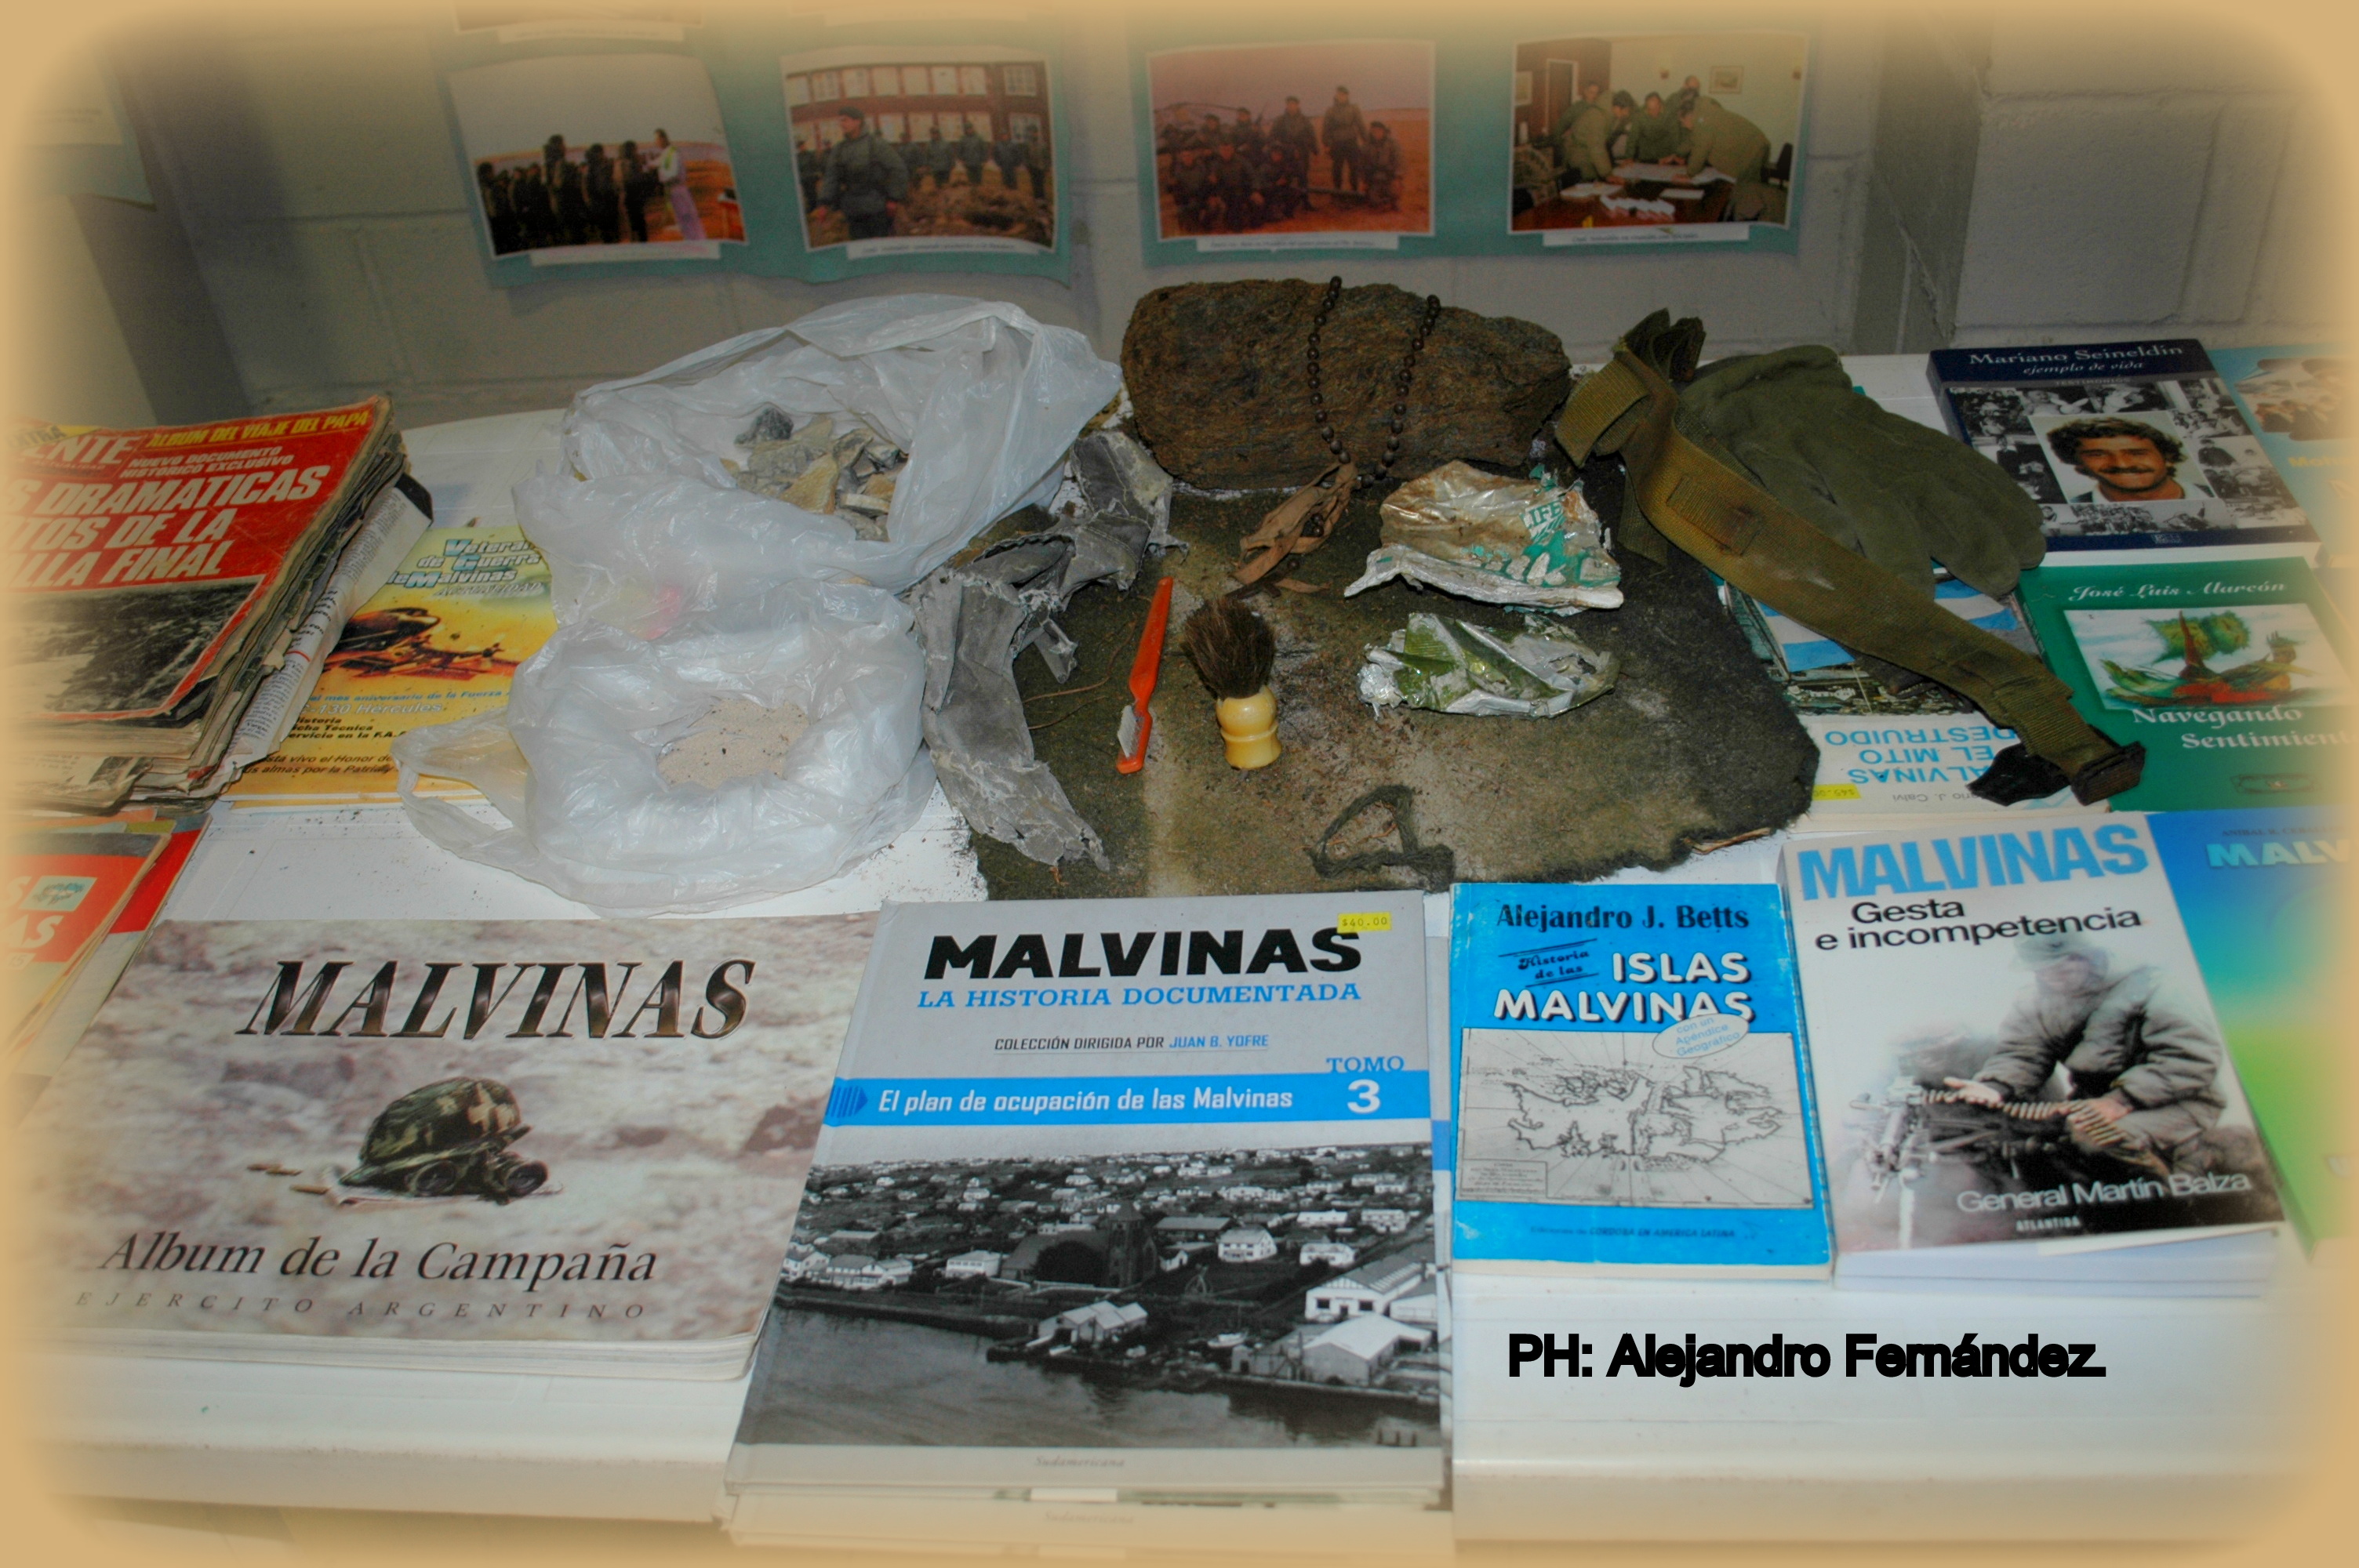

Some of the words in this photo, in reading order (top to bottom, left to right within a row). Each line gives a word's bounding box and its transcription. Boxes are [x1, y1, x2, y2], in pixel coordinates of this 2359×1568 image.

[1969, 353, 2068, 365] Mariano
[2074, 345, 2183, 361] Seineldin
[2023, 362, 2084, 375] ejemplo
[2089, 362, 2105, 371] de
[2110, 361, 2144, 371] vida
[146, 429, 209, 448] ALBUM
[209, 426, 238, 442] DEL
[242, 419, 291, 440] VIAJE
[291, 417, 320, 432] DEL
[322, 411, 371, 430] PAPA
[119, 464, 205, 479] HISTORICO
[205, 455, 296, 472] EXCLUSIVO
[129, 455, 185, 468] NUEVO
[184, 446, 283, 465] DOCUMENTO
[32, 465, 331, 515] DRAMATICAS
[104, 513, 176, 549] DE
[171, 508, 238, 543] LA
[99, 539, 235, 584] FINAL
[416, 555, 445, 569] de
[452, 554, 541, 572] Guerra
[405, 569, 518, 588] Malvinas
[2068, 585, 2125, 601] José
[2129, 584, 2181, 598] Luis
[354, 693, 424, 702] aniversario
[427, 691, 443, 700] de
[460, 690, 503, 699] Fuerza
[355, 702, 443, 714] Hércules
[2132, 705, 2303, 729] Navegando
[287, 731, 333, 739] ervicio
[357, 731, 370, 739] la
[325, 722, 373, 731] Técnica
[1825, 725, 2019, 746] DESTRUIDO
[264, 753, 288, 763] stá
[319, 753, 332, 763] el
[333, 754, 373, 763] Honor
[1859, 747, 1941, 764] MITO
[1950, 746, 1994, 761] EL
[261, 764, 300, 774] almas
[302, 765, 326, 775] por
[328, 764, 340, 774] la
[1848, 765, 1992, 784] ALVINAS
[1892, 793, 1928, 803] Calvi
[1797, 824, 2149, 901] MALVINAS
[1342, 916, 1388, 927] $40.00
[1496, 904, 1632, 935] Alejandro
[1642, 905, 1665, 928] J.
[1677, 904, 1750, 931] Betts
[1852, 898, 1965, 924] Gesta
[1815, 933, 1839, 950] e
[1848, 906, 2143, 950] incompetencia
[924, 927, 1362, 980] MALVINAS
[1518, 949, 1590, 970] Historia
[1535, 969, 1554, 979] de
[1558, 965, 1583, 975] las
[1612, 952, 1750, 984] ISLAS
[234, 959, 757, 1040] MALVINAS
[917, 990, 955, 1008] LA
[965, 988, 1112, 1008] HISTORIA
[1121, 983, 1362, 1006] DOCUMENTADA
[1493, 989, 1756, 1022] MALVINAS
[1676, 1022, 1698, 1033] con
[1699, 1017, 1714, 1027] un
[1676, 1023, 1729, 1045] Apéndice
[994, 1035, 1070, 1051] COLECCIÓN
[1074, 1036, 1132, 1050] DIRIGIDA
[1137, 1036, 1165, 1049] POR
[1169, 1035, 1206, 1048] JUAN
[1209, 1035, 1223, 1047] B.
[1227, 1034, 1269, 1047] YOFRE
[1676, 1031, 1741, 1056] Geográfico
[1326, 1056, 1405, 1073] TOMO
[878, 1089, 900, 1112] El
[903, 1089, 952, 1116] plan
[958, 1089, 987, 1112] de
[993, 1091, 1110, 1116] ocupación
[1117, 1088, 1144, 1110] de
[1151, 1087, 1185, 1109] las
[1192, 1087, 1292, 1109] Malvinas
[1347, 1079, 1381, 1114] 3
[1957, 1183, 2068, 1213] General
[2073, 1177, 2164, 1206] Martín
[2168, 1171, 2252, 1197] Balza
[1653, 1229, 1697, 1237] AMERICA
[2016, 1215, 2081, 1232] ATLANTIDA
[97, 1231, 267, 1275] Album
[279, 1236, 342, 1277] de
[351, 1237, 402, 1279] la
[415, 1241, 659, 1293] Campaña
[75, 1290, 316, 1314] EJERCITO
[347, 1300, 648, 1319] ARGENTINO
[1036, 1454, 1125, 1468] Sudamericana
